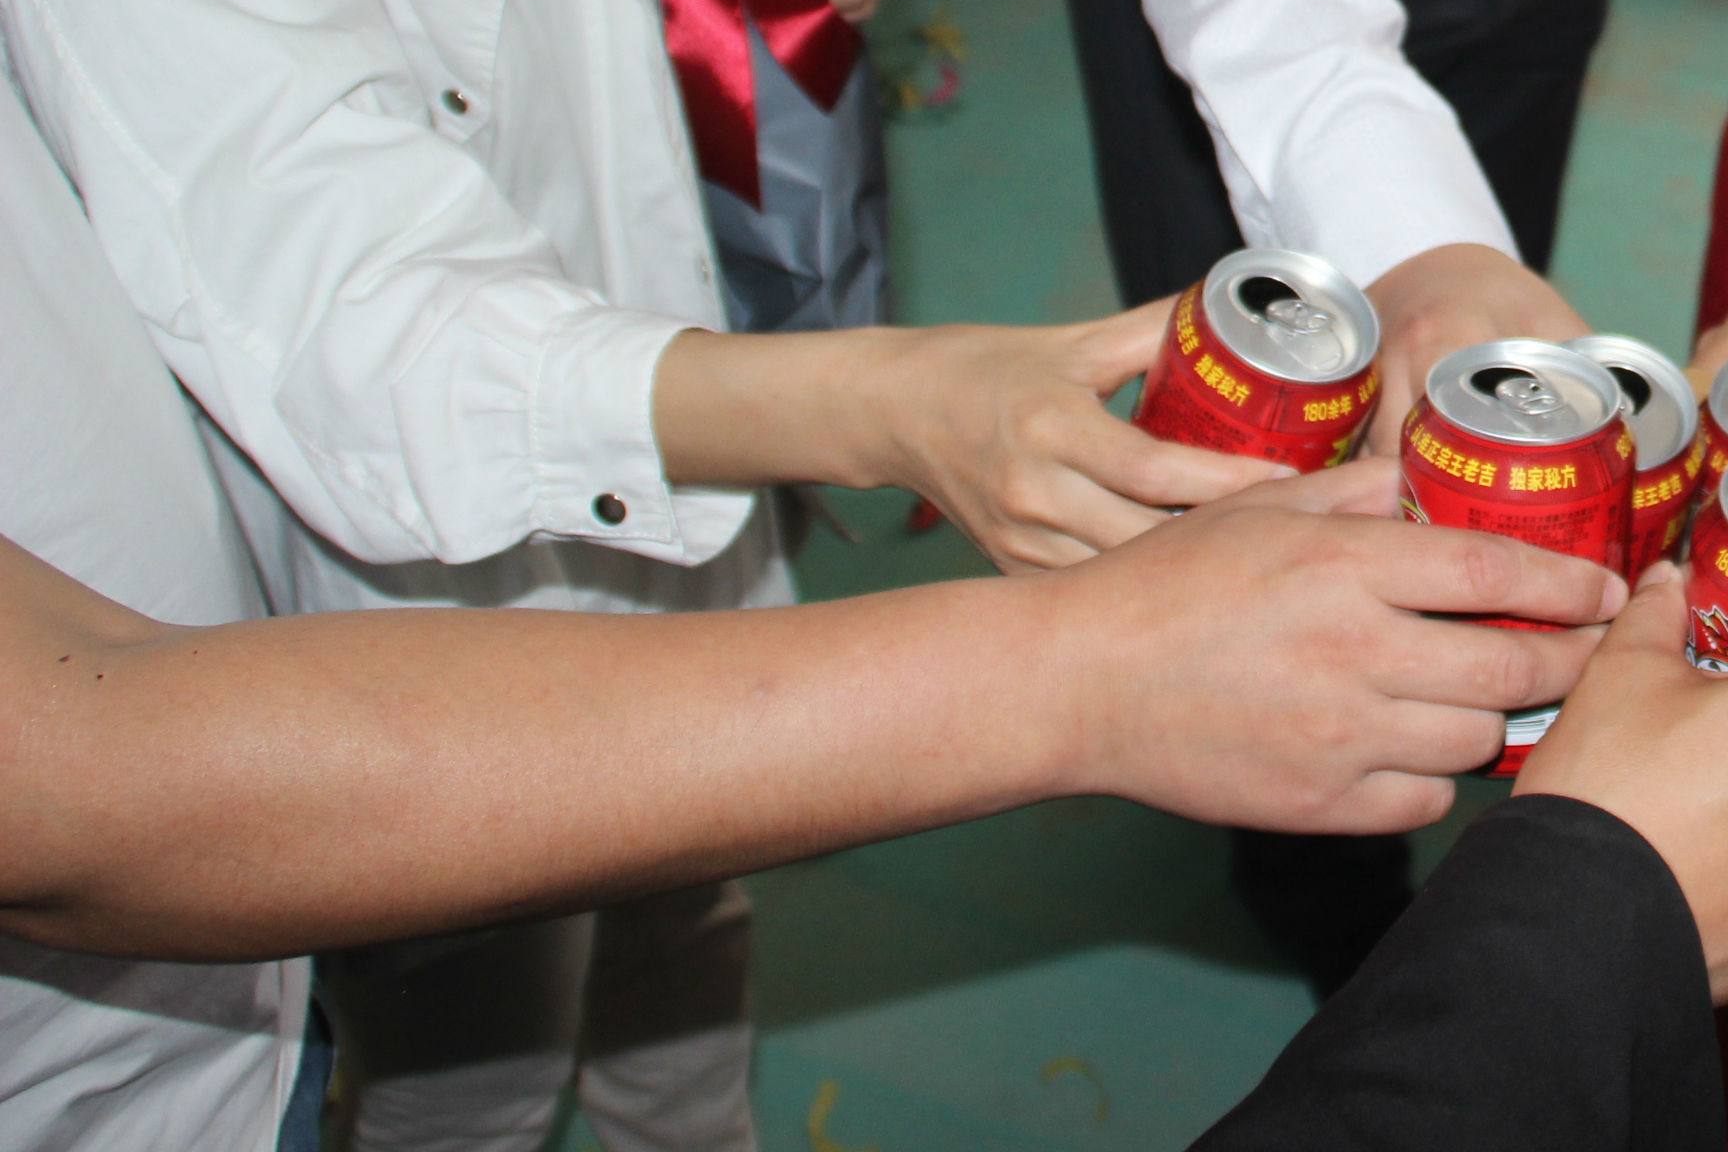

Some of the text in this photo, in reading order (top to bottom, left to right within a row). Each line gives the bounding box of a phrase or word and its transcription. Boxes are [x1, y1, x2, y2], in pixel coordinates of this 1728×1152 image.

[1302, 394, 1353, 423] 180余年
[1508, 463, 1577, 493] 独家秘方
